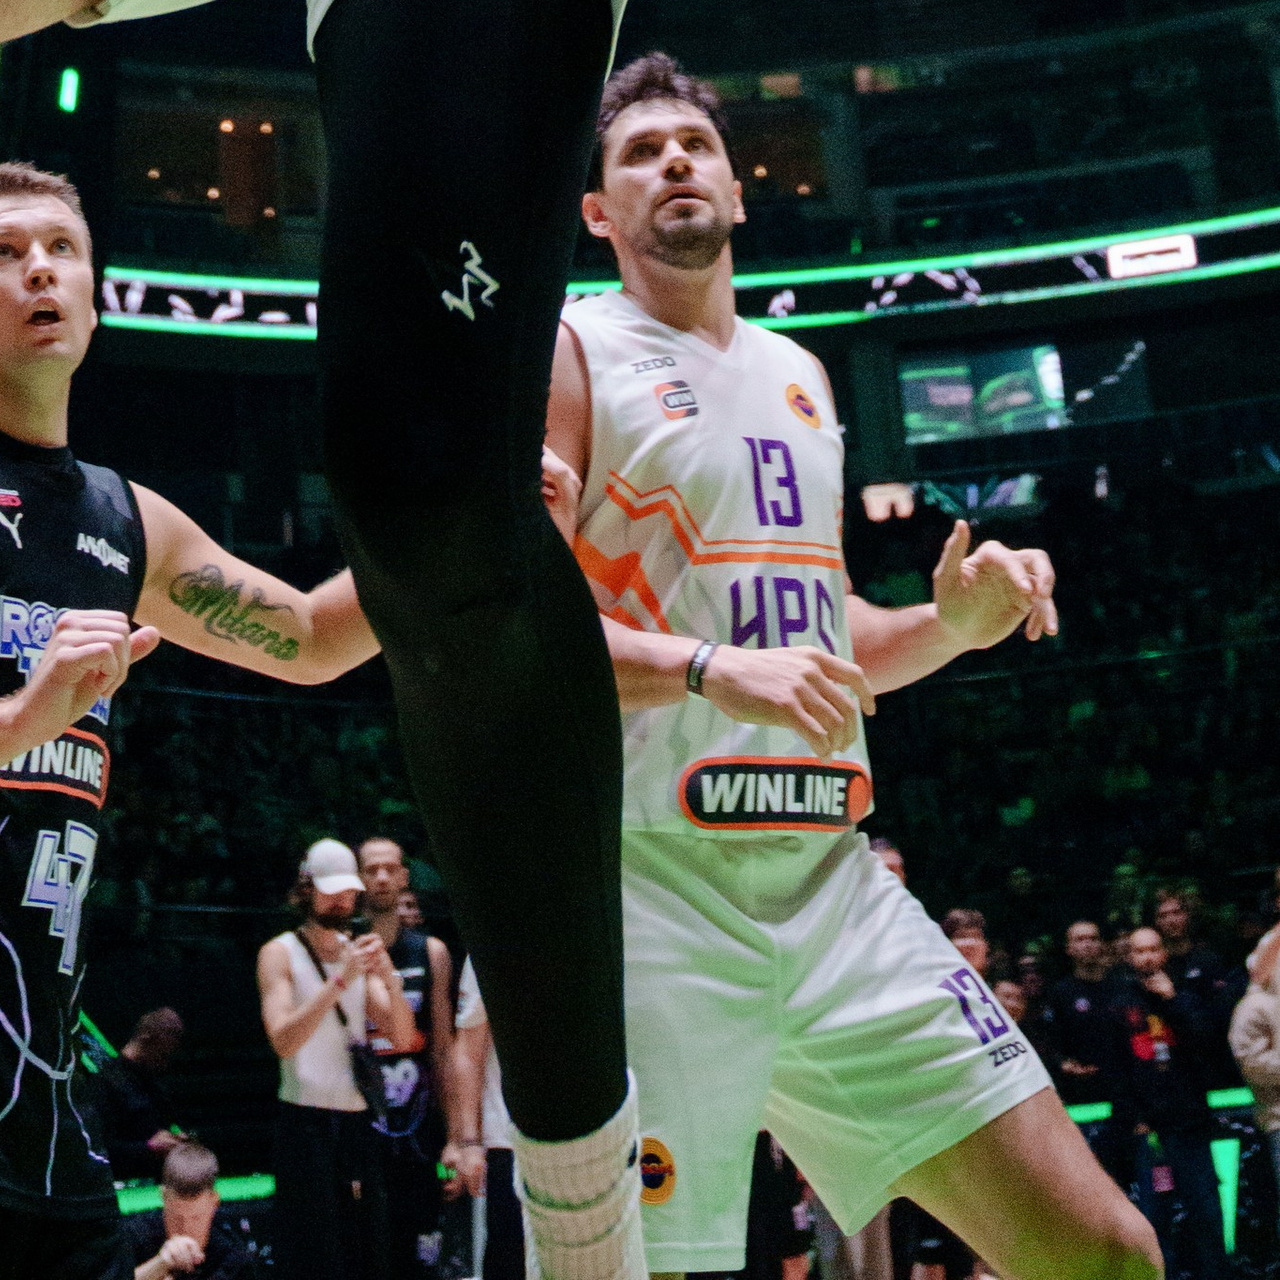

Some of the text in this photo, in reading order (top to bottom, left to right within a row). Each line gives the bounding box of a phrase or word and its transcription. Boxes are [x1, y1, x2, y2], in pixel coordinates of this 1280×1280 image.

[631, 355, 677, 374] ZEDO
[741, 435, 804, 528] 13
[700, 772, 848, 817] WINLINE
[21, 819, 99, 977] 47
[936, 967, 1010, 1045] 13
[988, 1040, 1027, 1067] ZEDO
